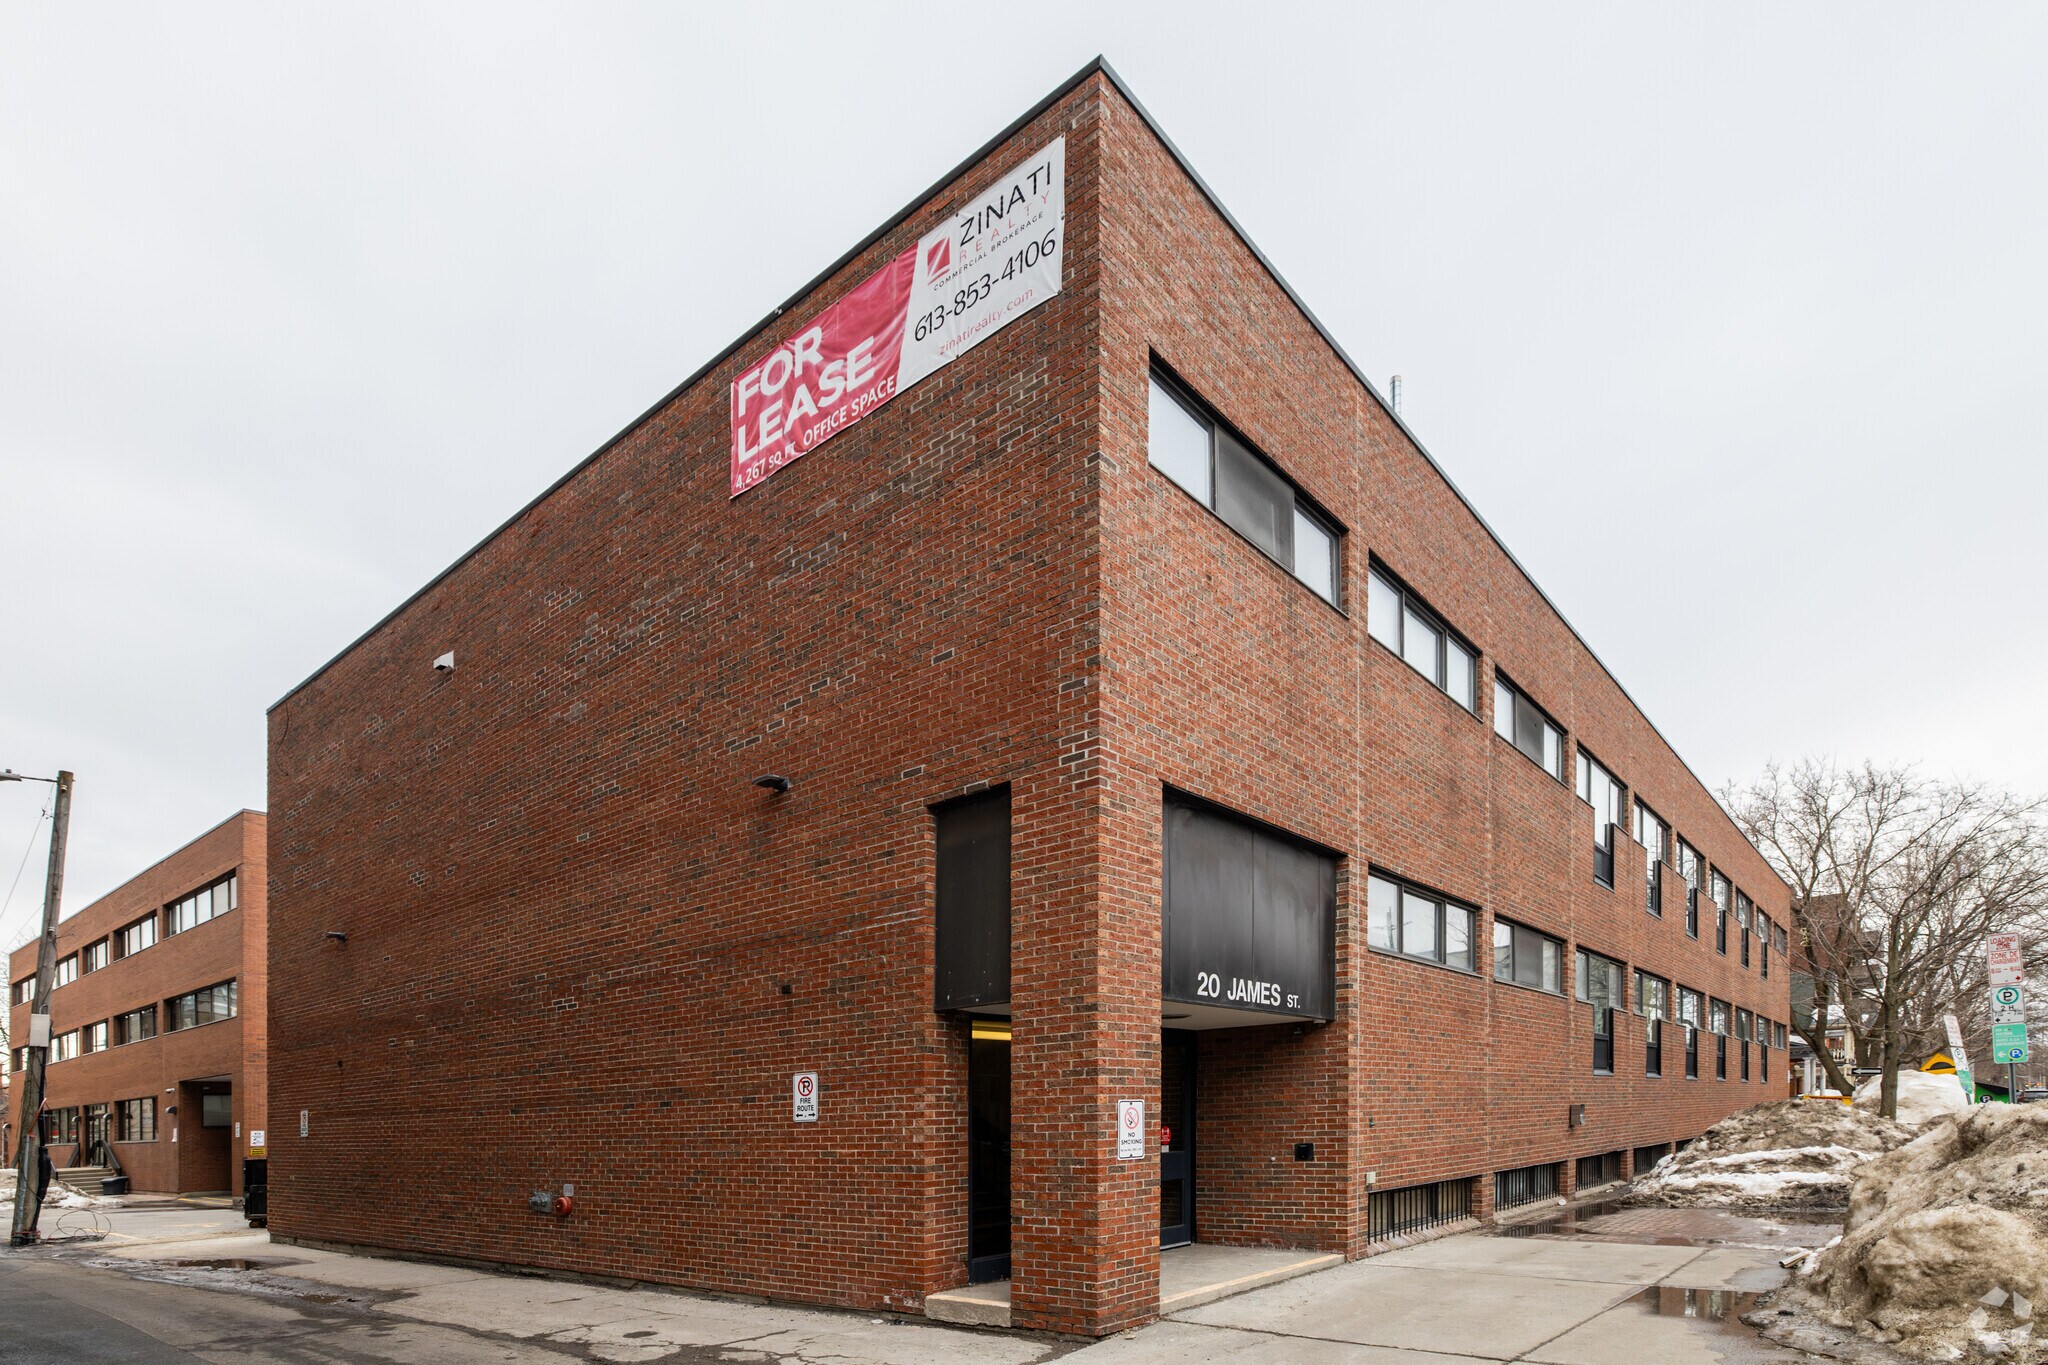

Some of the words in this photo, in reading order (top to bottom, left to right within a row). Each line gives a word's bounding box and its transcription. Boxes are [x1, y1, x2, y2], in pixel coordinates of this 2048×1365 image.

[959, 161, 1051, 248] ZINATI
[959, 190, 1050, 265] REALTY
[914, 227, 1057, 342] 613-853-4106
[933, 251, 988, 292] COMMERCIAL
[990, 211, 1044, 252] BROKERAGE
[939, 287, 1034, 357] zinatirealty.com
[737, 325, 824, 418] FOR
[737, 335, 875, 464] LEASE
[768, 450, 783, 469] SQ
[802, 407, 848, 447] OFFICE
[851, 373, 896, 418] SPACE
[1989, 935, 2016, 945] LOADING
[1196, 971, 1221, 998] 20
[1227, 977, 1281, 1007] JAMES
[1286, 994, 1301, 1009] ST.
[1120, 1138, 1143, 1146] SMOKING
